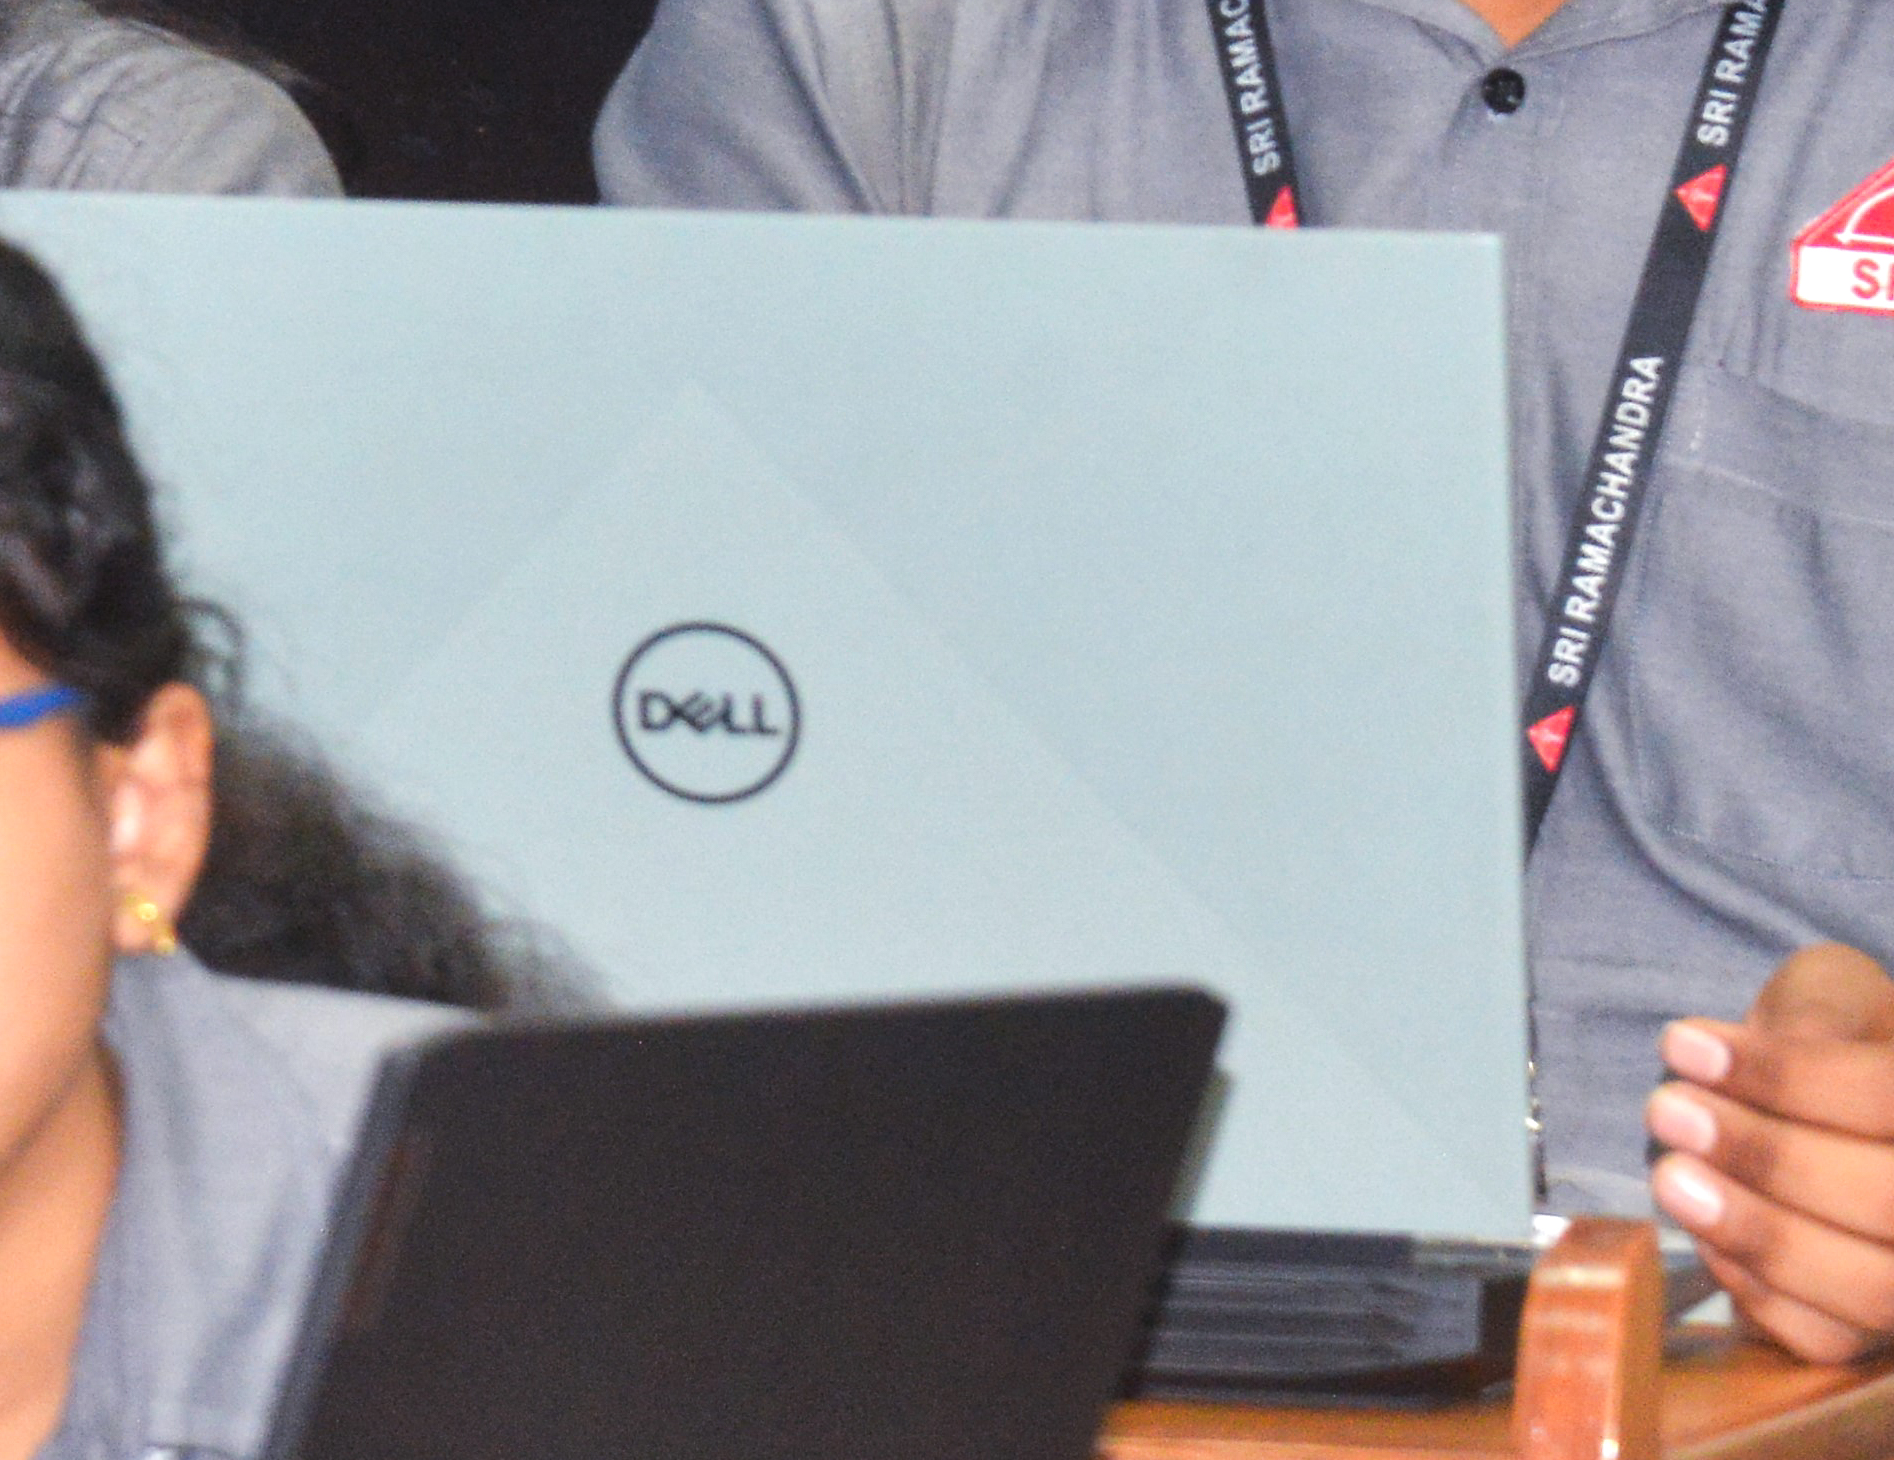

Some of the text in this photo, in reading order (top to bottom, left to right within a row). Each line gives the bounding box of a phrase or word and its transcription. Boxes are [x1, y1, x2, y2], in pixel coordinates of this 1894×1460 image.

[1697, 89, 1740, 147] SRI
[1246, 122, 1281, 177] SRI
[1548, 355, 1664, 688] SRI RAMACHANDRA
[638, 690, 779, 735] DELL
